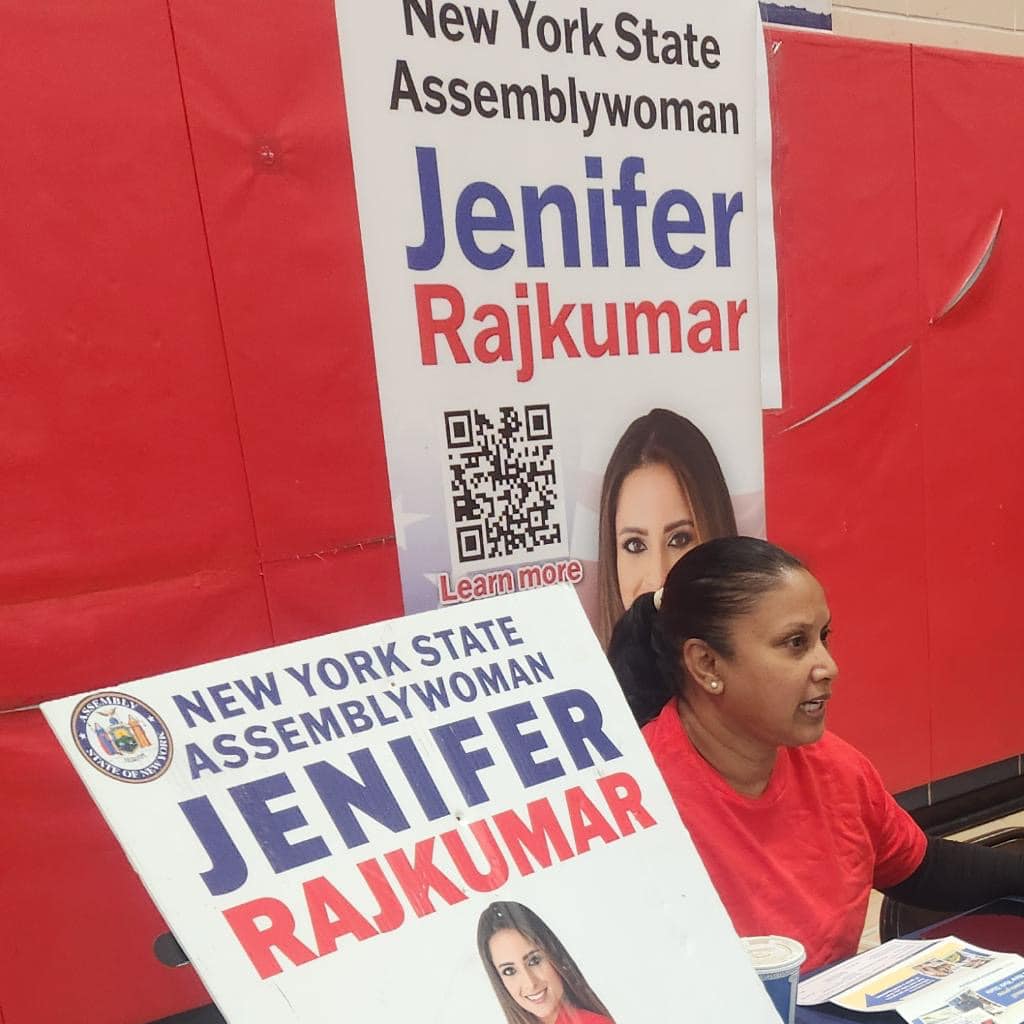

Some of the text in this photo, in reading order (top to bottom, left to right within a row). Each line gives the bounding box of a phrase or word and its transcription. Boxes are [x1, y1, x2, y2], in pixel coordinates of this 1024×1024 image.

[403, 0, 721, 69] New York State
[390, 60, 739, 138] Assemblywoman
[406, 146, 744, 271] Jenifer
[414, 282, 748, 383] Rajkumar
[440, 560, 582, 602] Learn more
[80, 696, 138, 722] ASSEMBLY
[173, 615, 524, 729] NEW YORK STATE
[184, 651, 556, 780] ASSEMBLYWOMAN
[86, 748, 120, 776] STATE
[121, 771, 140, 779] OF
[140, 759, 163, 778] NEW
[178, 688, 624, 897] JENIFER
[223, 771, 658, 981] RAJKUMAR
